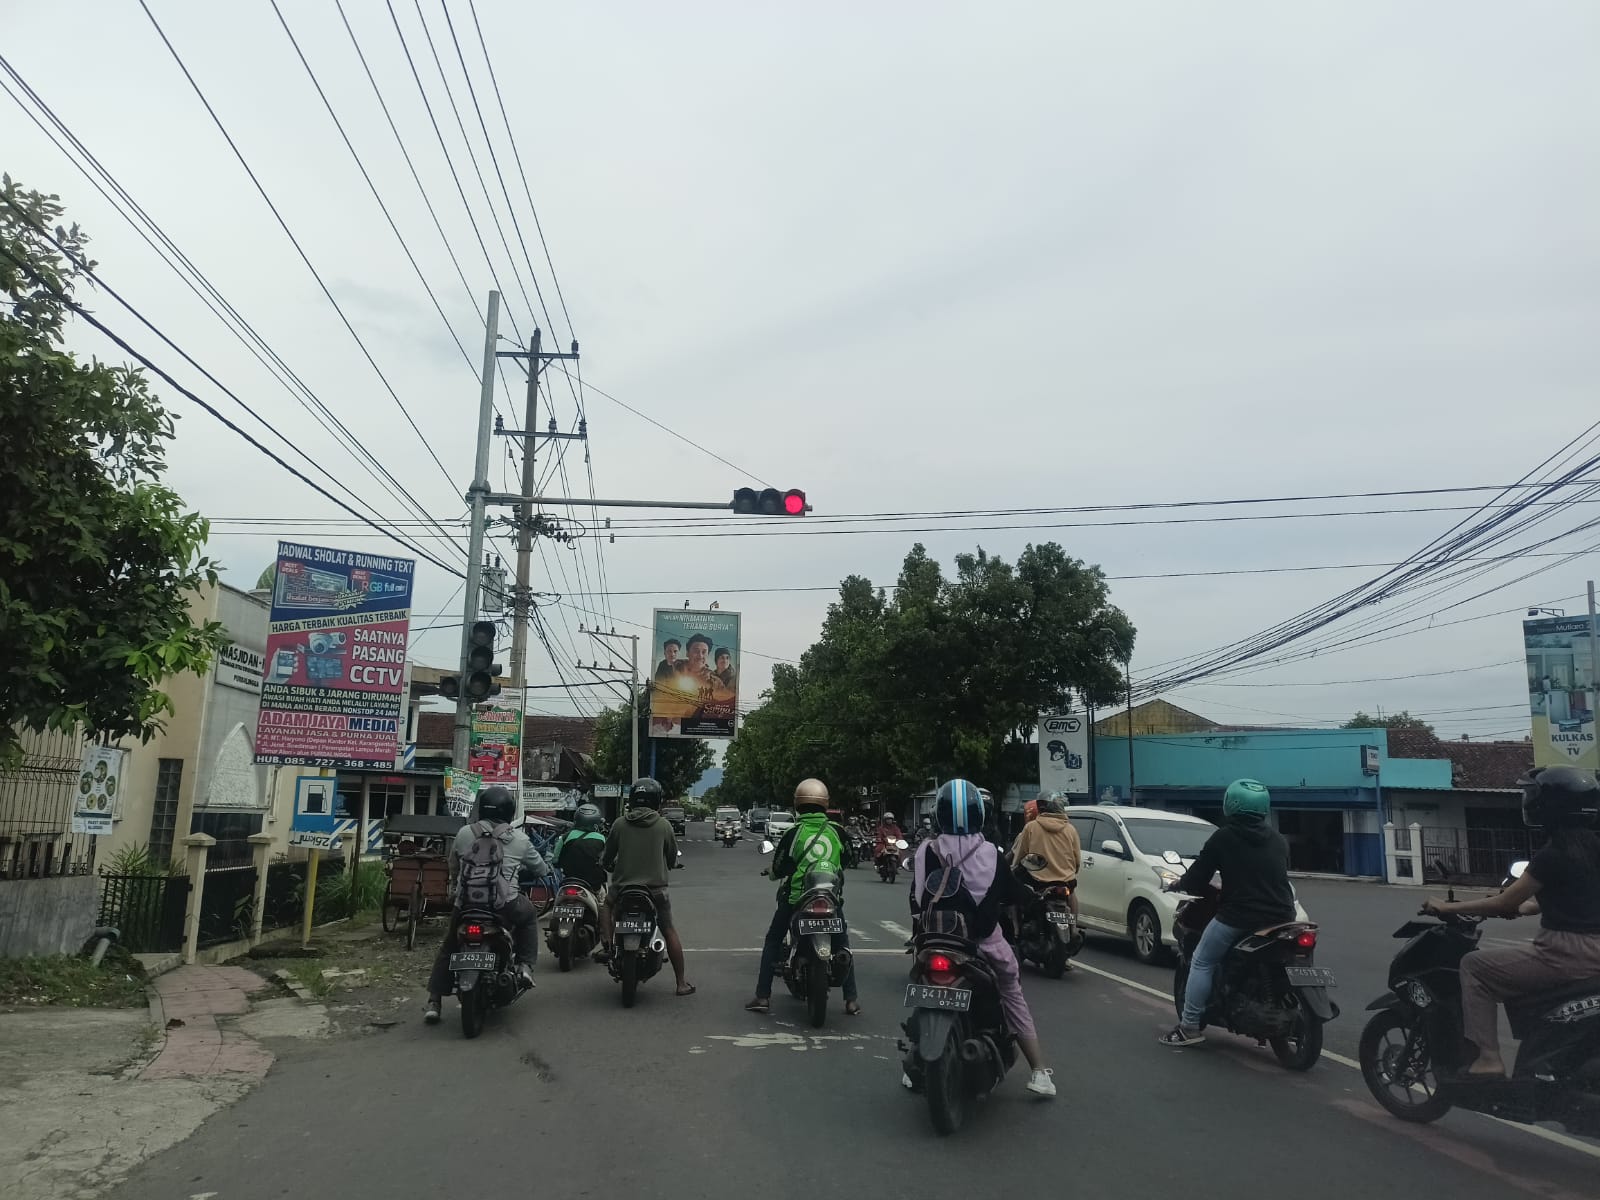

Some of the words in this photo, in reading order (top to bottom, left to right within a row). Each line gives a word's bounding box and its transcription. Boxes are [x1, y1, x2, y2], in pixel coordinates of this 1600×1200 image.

[279, 544, 312, 560] JADWAL
[314, 550, 345, 564] SHOLAT
[348, 556, 354, 566] &
[356, 557, 392, 570] RUNNING
[394, 561, 413, 574] TEXT
[361, 582, 383, 593] RGB
[272, 622, 300, 633] HARGA
[302, 618, 335, 630] TERBAIK
[337, 614, 374, 626] KUALITAS
[376, 610, 406, 622] TERBAIK
[683, 622, 707, 630] TERANG
[354, 628, 405, 646] SAATNYA
[352, 645, 404, 664] PASANG
[349, 665, 402, 686] CCTV
[263, 684, 289, 695] ANDA
[291, 686, 317, 696] SIBUK
[319, 689, 325, 697] &
[327, 690, 360, 700] JARANG
[362, 692, 401, 703] DIRUMAH
[322, 698, 341, 706] ANDA
[314, 704, 342, 712] BERADA
[342, 706, 374, 715] NONSTOP
[375, 708, 384, 716] 24
[385, 710, 399, 718] JAM
[259, 710, 310, 728] ADAM
[310, 714, 347, 731] JAYA
[348, 716, 398, 734] MEDIA
[259, 727, 304, 736] LAYANAN
[306, 730, 331, 738] JASA
[341, 732, 372, 740] PURNA
[374, 734, 397, 742] JUAL
[1552, 733, 1594, 742] KULKAS
[1566, 748, 1581, 756] TV
[256, 756, 282, 764] HUB.
[284, 758, 305, 766] 085
[315, 759, 336, 767] 727
[372, 762, 393, 770] 485
[910, 987, 917, 997] R
